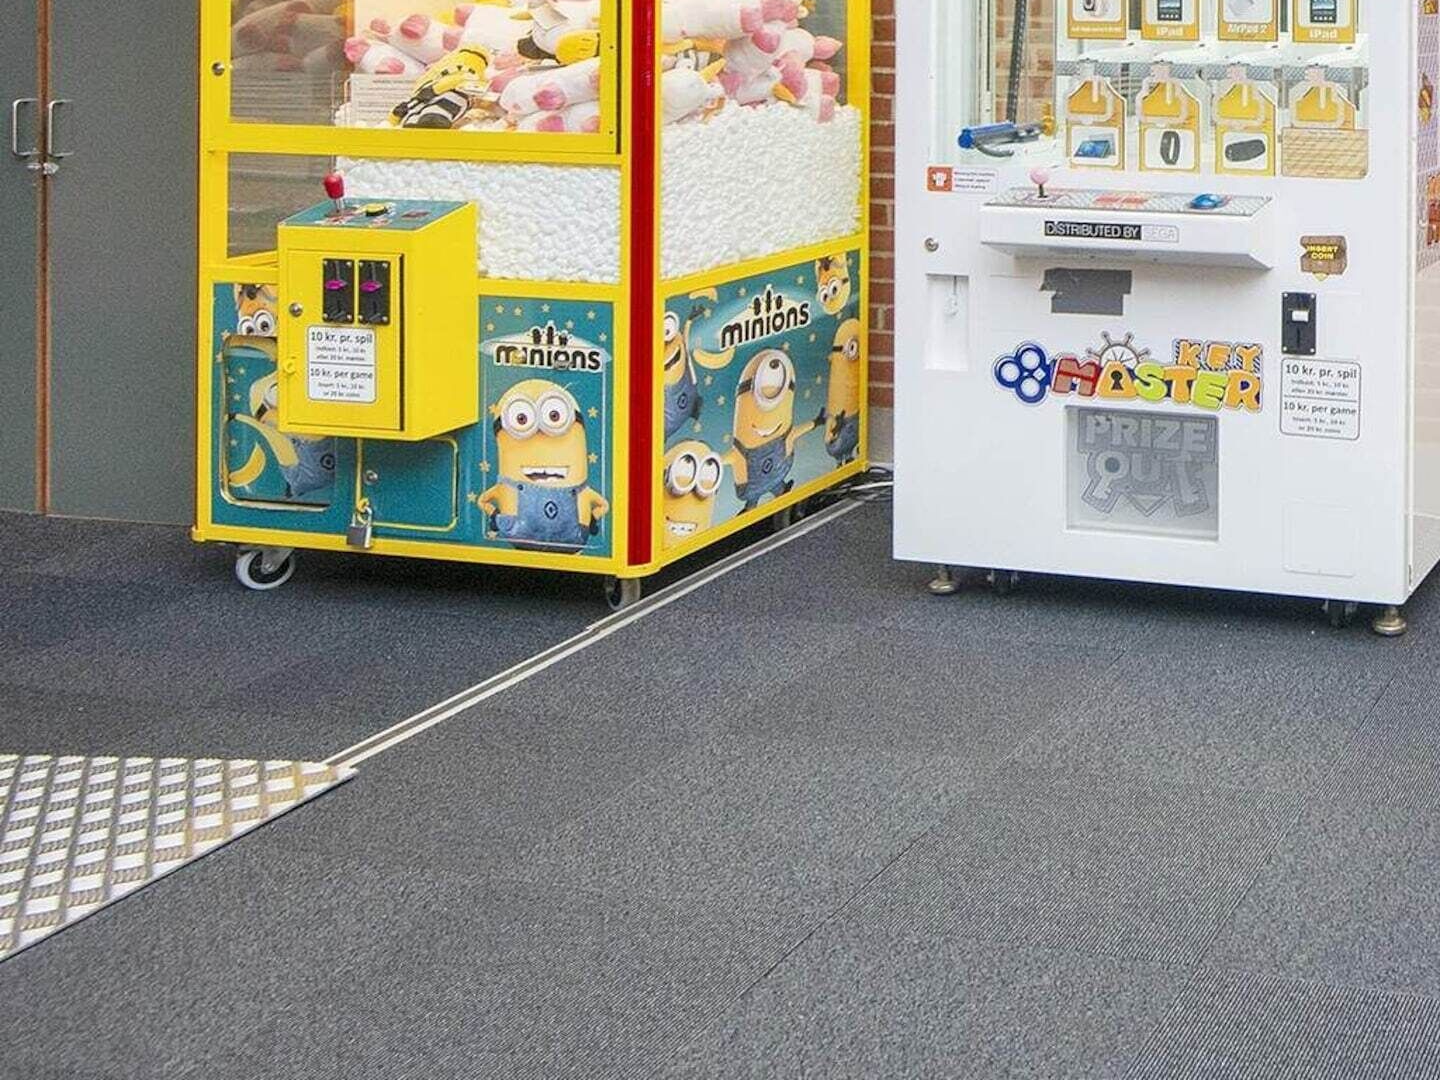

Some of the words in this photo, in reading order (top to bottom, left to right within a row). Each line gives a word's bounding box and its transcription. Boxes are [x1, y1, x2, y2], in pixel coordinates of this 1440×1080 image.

[1047, 222, 1120, 237] DISTRIBUTED
[1122, 225, 1140, 239] BY
[720, 302, 811, 350] minions
[311, 331, 323, 341] 10
[355, 333, 373, 345] spil
[1179, 340, 1261, 371] KEY
[310, 368, 320, 376] 10
[334, 371, 349, 379] per
[350, 372, 373, 380] game
[1286, 364, 1299, 374] 10
[1302, 364, 1316, 376] kr.
[1319, 368, 1334, 378] pr.
[1337, 367, 1357, 380] spil
[1052, 357, 1261, 410] MASTER
[1284, 401, 1295, 410] 10
[1297, 402, 1310, 412] kr.
[1311, 406, 1328, 414] per
[1330, 407, 1357, 416] game
[1086, 414, 1208, 452] PRIZE
